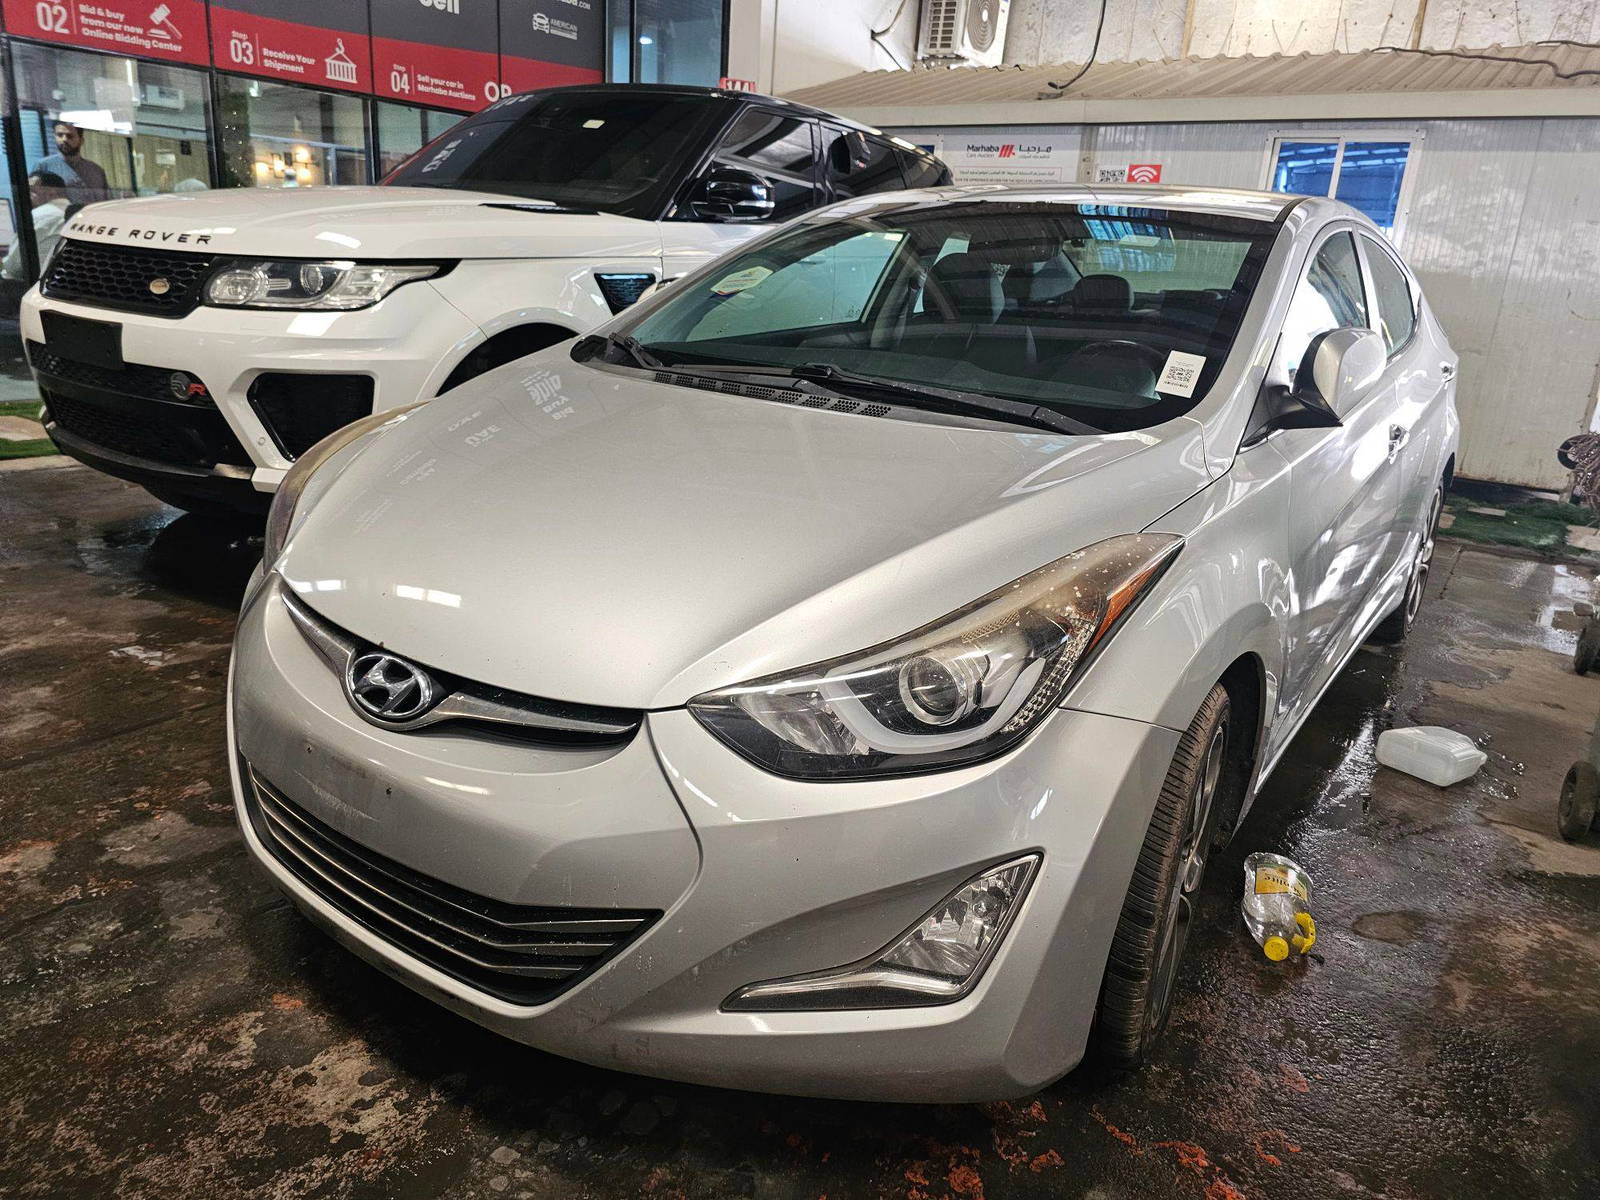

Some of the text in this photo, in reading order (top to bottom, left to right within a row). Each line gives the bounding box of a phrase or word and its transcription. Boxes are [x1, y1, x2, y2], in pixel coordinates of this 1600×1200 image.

[35, 2, 69, 34] 02
[79, 4, 125, 21] Bid & buy
[81, 16, 143, 34] from our new
[82, 27, 182, 52] Online Bidding Center
[230, 39, 254, 65] 03
[262, 48, 315, 65] Receive Your
[264, 59, 304, 73] Shipment
[390, 71, 410, 94] 04
[417, 74, 464, 89] Sell your car in
[417, 84, 476, 101] Marhaba Auctions
[966, 144, 1000, 152] Marhaba
[70, 223, 212, 245] RANGE ROVER
